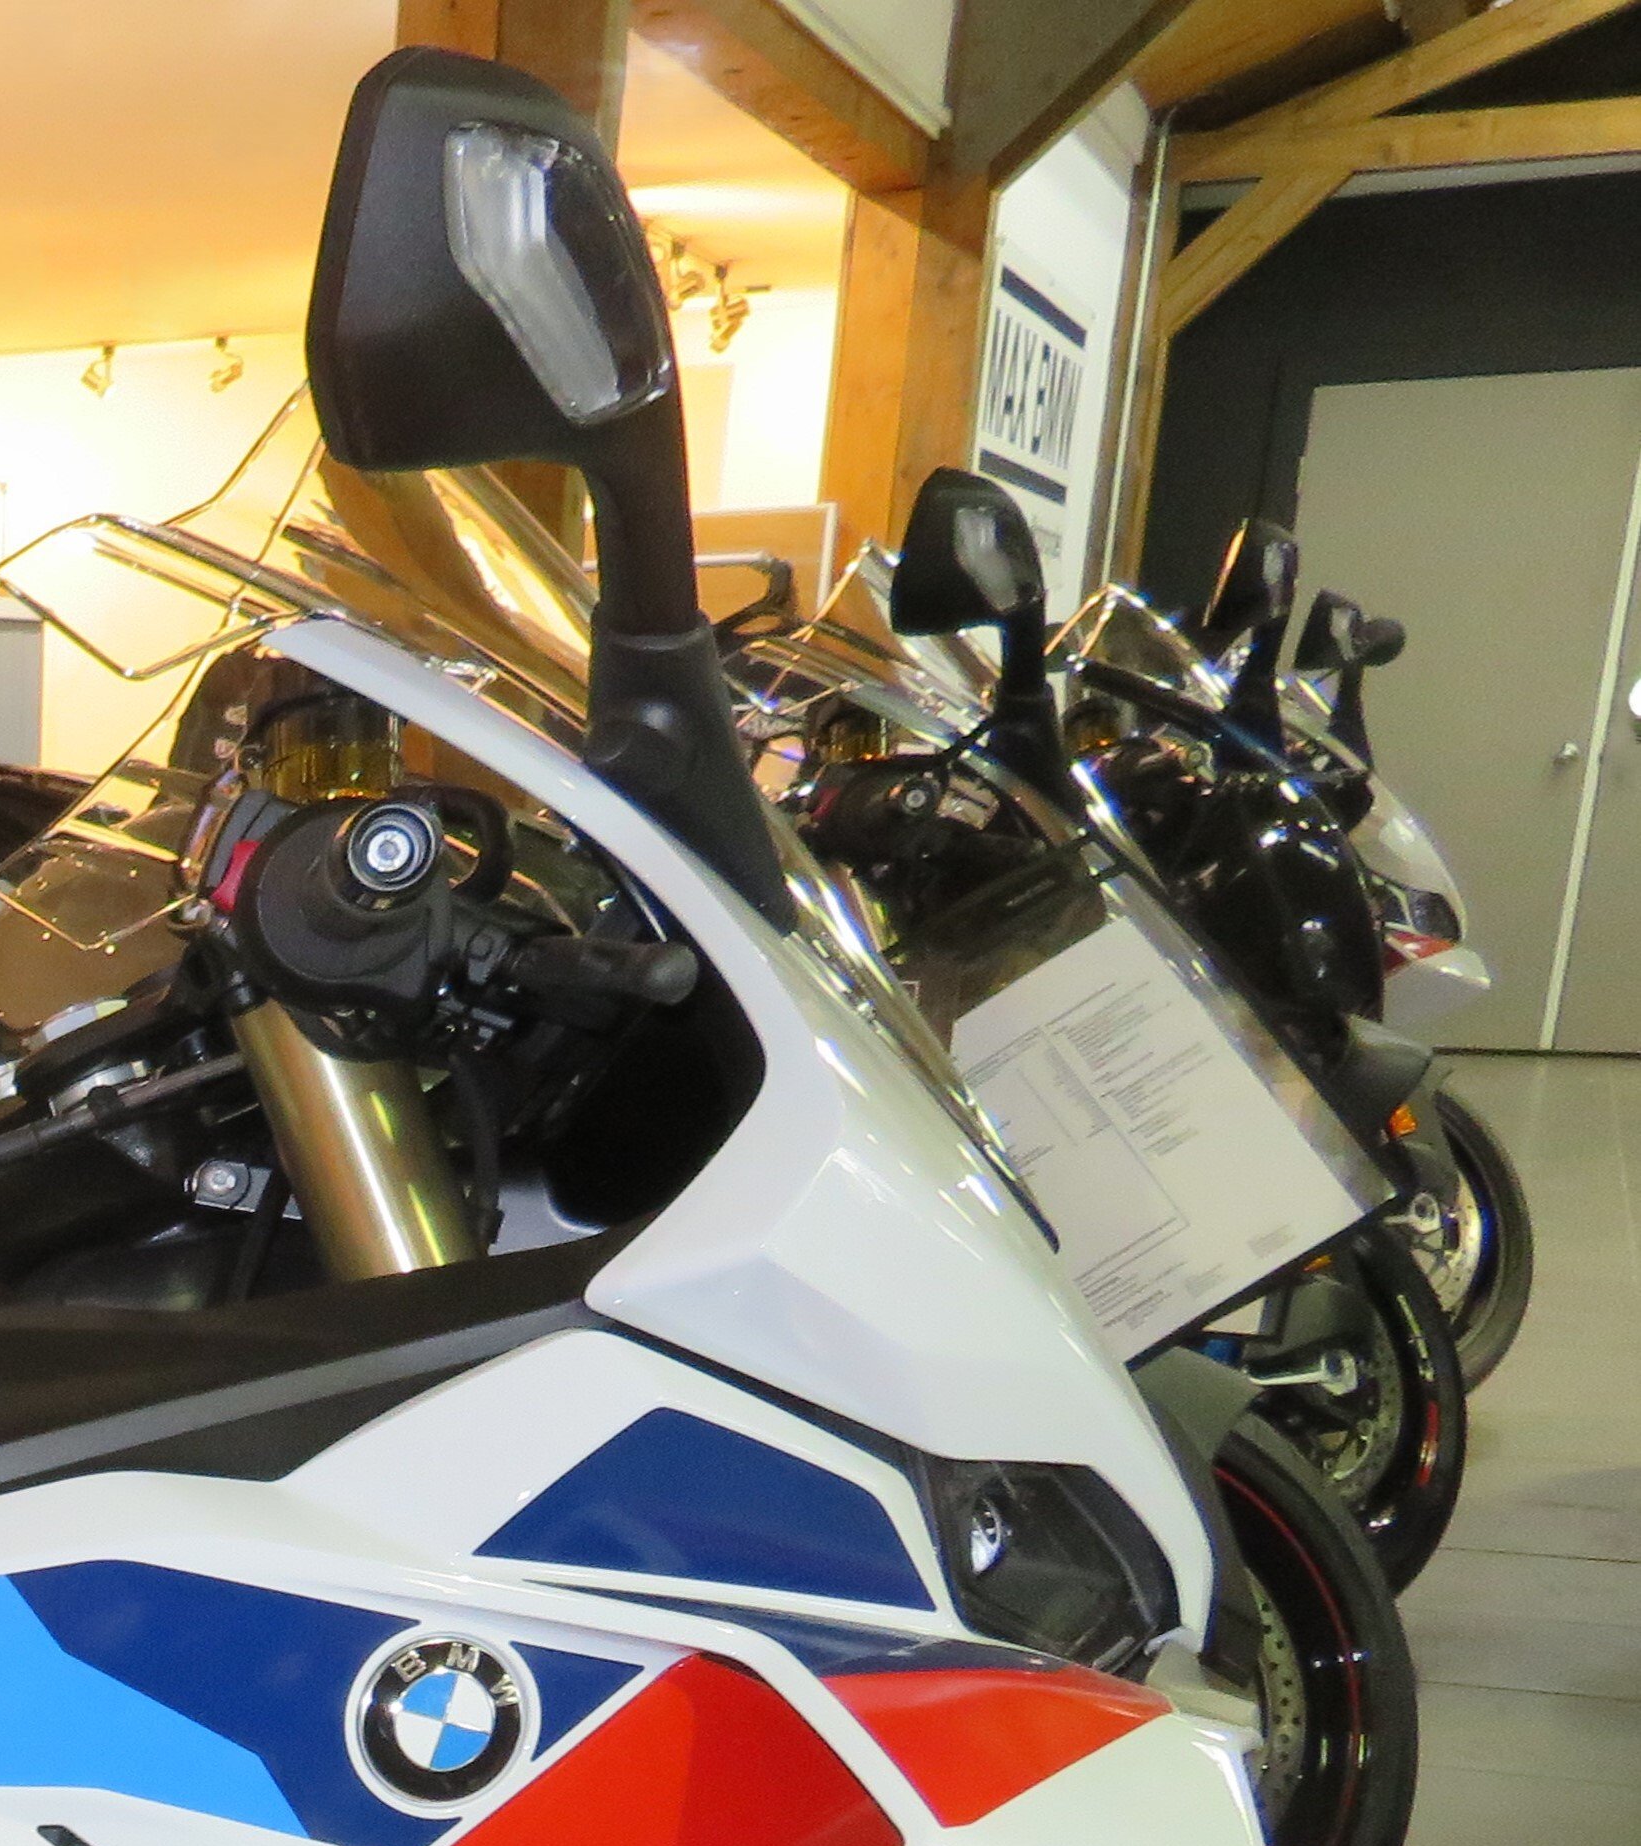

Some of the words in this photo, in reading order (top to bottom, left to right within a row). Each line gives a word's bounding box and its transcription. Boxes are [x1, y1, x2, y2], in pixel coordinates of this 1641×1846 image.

[981, 308, 1037, 450] MAX
[1031, 340, 1083, 471] BMW
[393, 1642, 518, 1706] BMW
